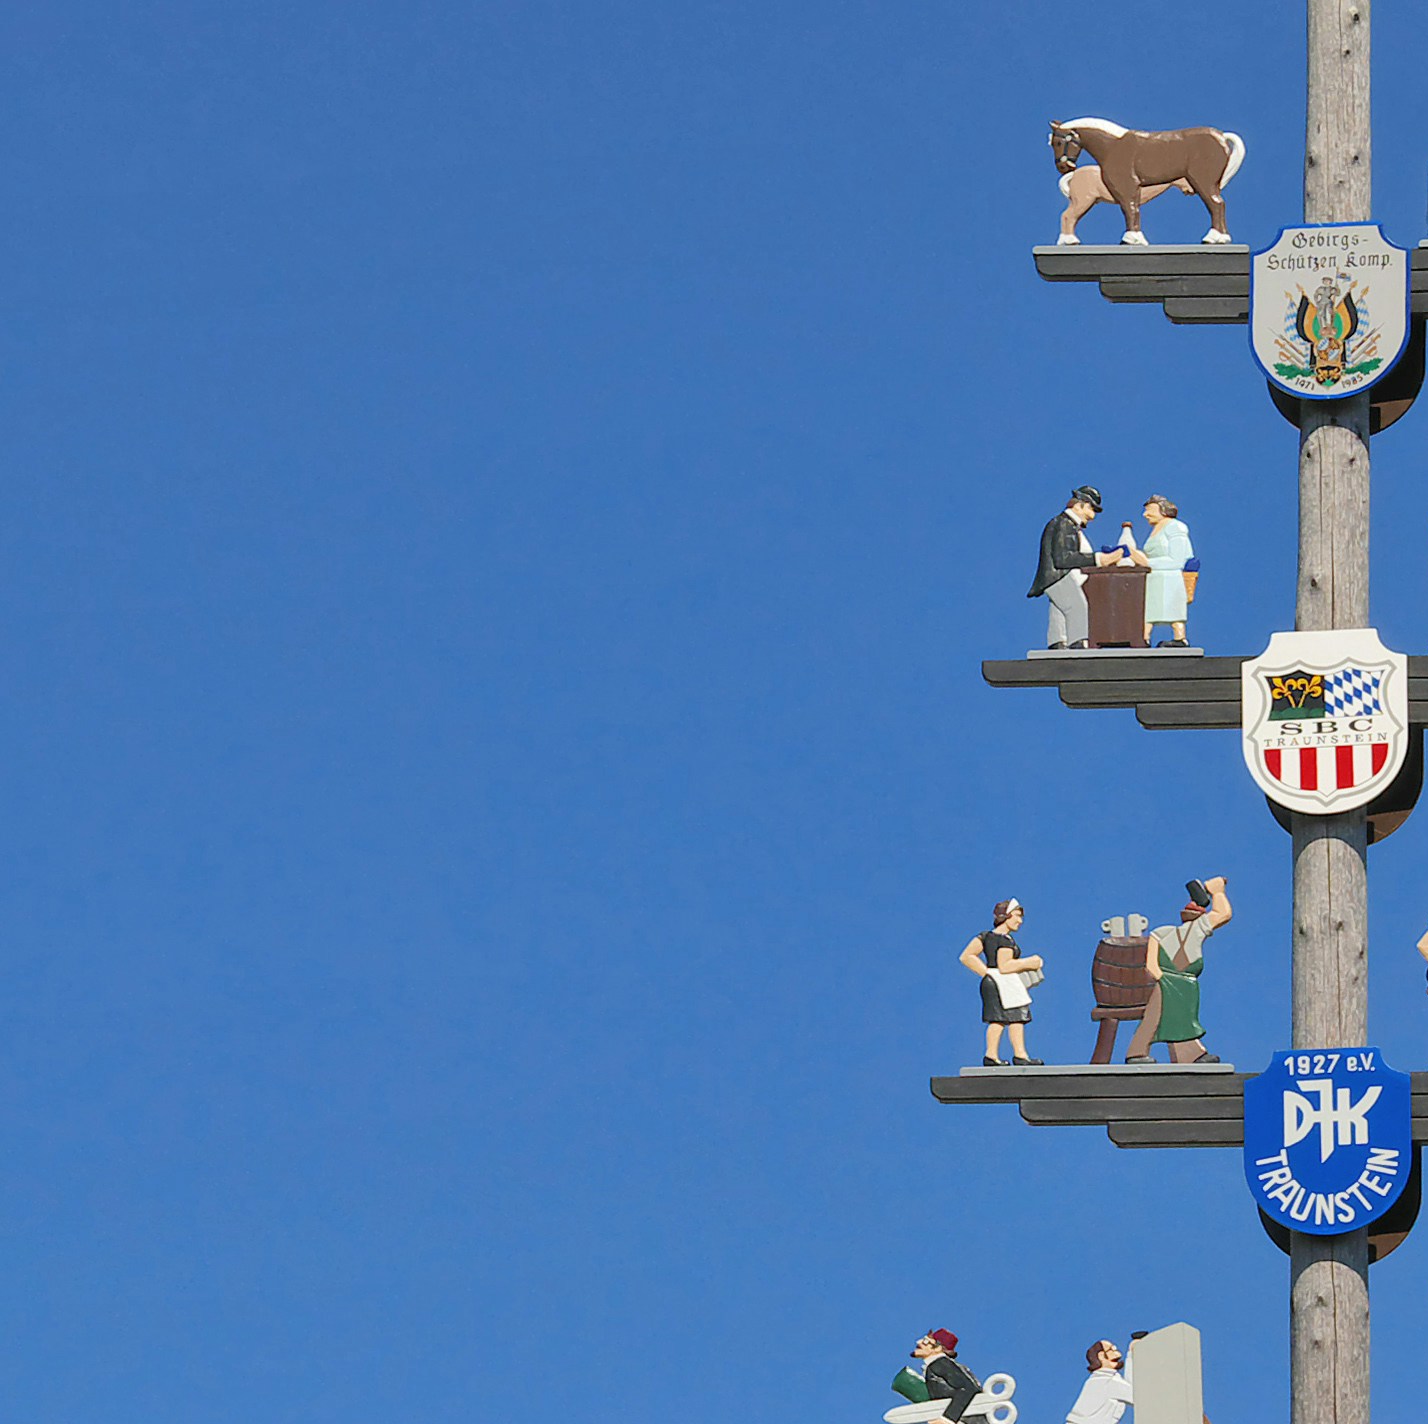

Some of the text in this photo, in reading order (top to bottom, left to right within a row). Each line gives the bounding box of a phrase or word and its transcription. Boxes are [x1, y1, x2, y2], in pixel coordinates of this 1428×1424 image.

[1292, 232, 1368, 250] Gebirgs-
[1264, 732, 1388, 747] TRAUNSTEIN
[1284, 1052, 1376, 1076] 1927 e.V.
[1283, 1078, 1383, 1164] DJK
[1255, 1147, 1400, 1225] TRAUNSTEIN
